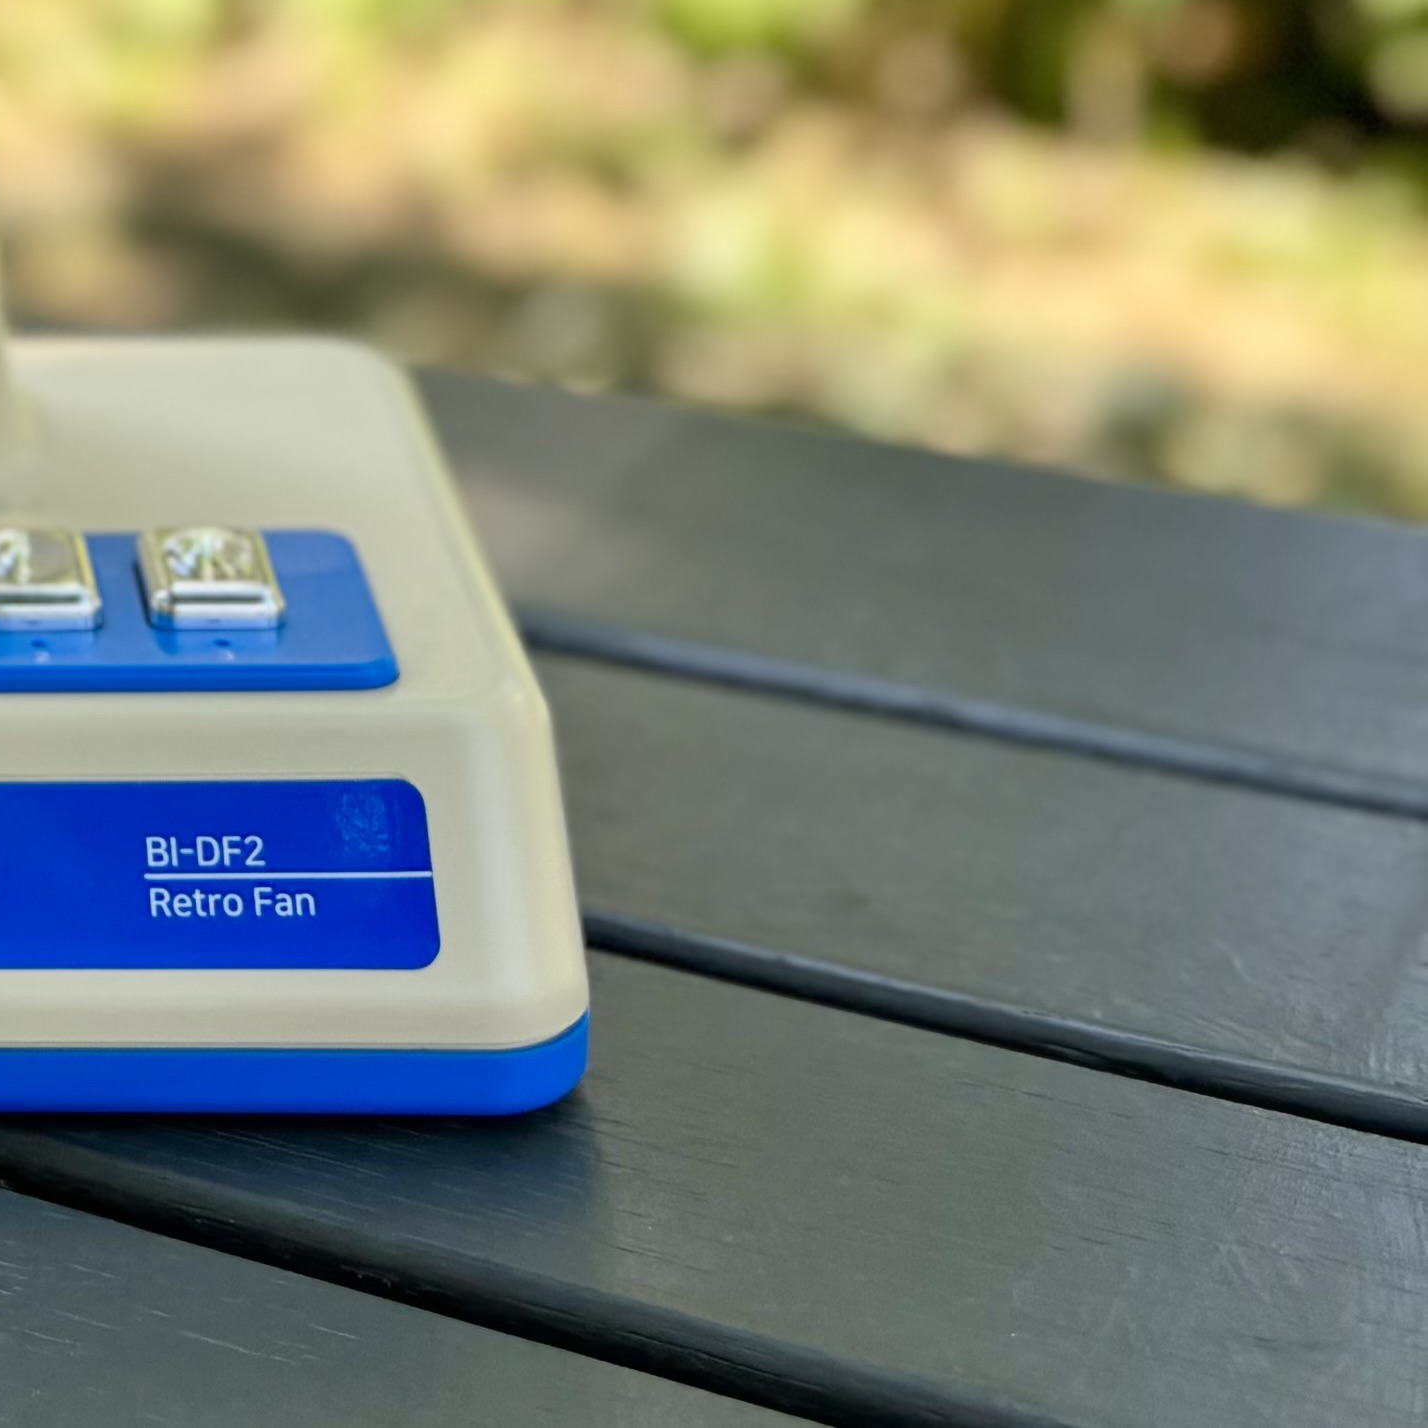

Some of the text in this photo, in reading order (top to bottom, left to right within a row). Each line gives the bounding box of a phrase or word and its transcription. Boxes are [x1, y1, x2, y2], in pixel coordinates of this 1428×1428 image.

[145, 835, 266, 868] BI-DF2
[149, 886, 315, 917] Retro Fan
